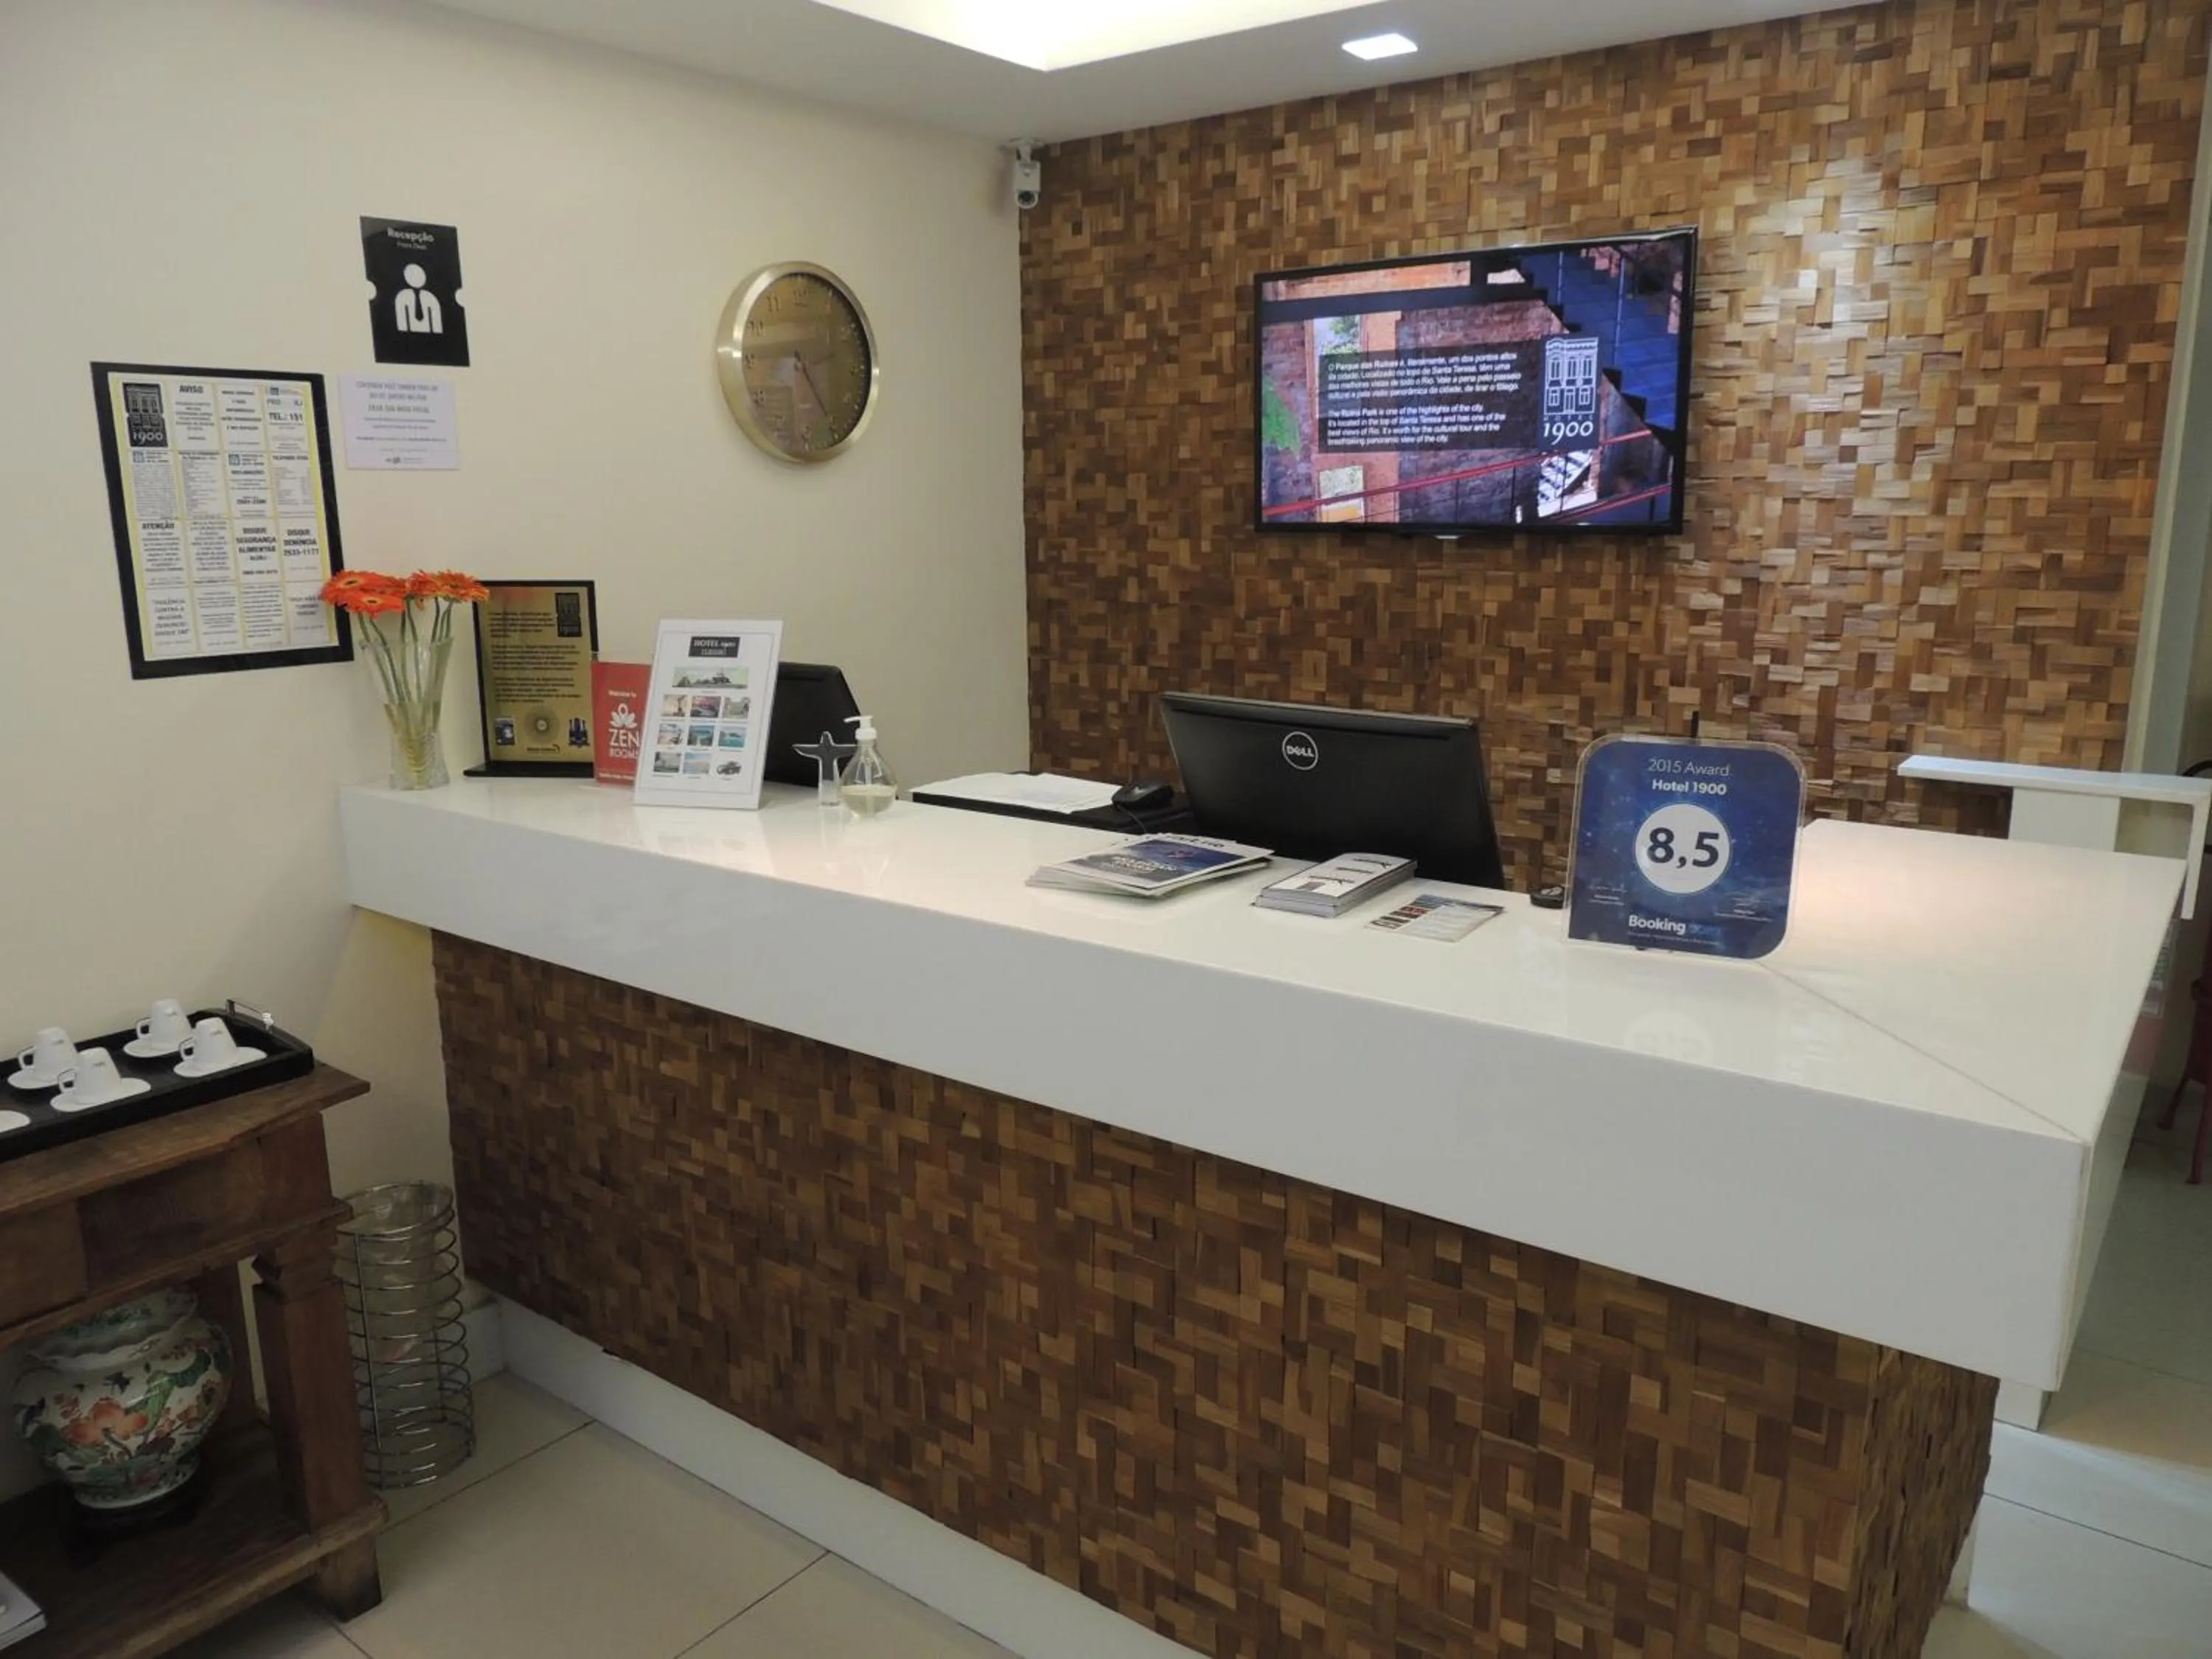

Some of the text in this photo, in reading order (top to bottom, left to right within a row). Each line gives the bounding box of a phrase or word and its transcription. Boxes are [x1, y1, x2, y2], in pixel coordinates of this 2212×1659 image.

[388, 227, 434, 243] Recepção
[1335, 362, 1359, 371] Parque
[1361, 361, 1372, 369] das
[1475, 354, 1499, 364] pontos
[1500, 352, 1517, 361] altos
[1361, 369, 1396, 379] Localizado
[1432, 366, 1452, 375] Santa
[1340, 381, 1369, 389] melhores
[1458, 375, 1476, 384] pena
[1477, 374, 1492, 383] pelo
[1493, 373, 1521, 382] passeio
[178, 385, 204, 393] AVISO
[1328, 409, 1340, 417] The
[1341, 408, 1360, 417] Ruins
[1362, 408, 1377, 416] Park
[1419, 406, 1450, 415] highlights
[1459, 403, 1471, 412] the
[1338, 418, 1360, 427] located
[1399, 416, 1418, 424] Santa
[1419, 414, 1442, 423] Teresa
[1443, 414, 1456, 422] and
[1457, 414, 1470, 422] has
[1494, 412, 1506, 421] the
[1328, 429, 1341, 437] best
[1393, 425, 1411, 434] worth
[1421, 425, 1433, 433] the
[1433, 424, 1458, 432] cultural
[1458, 424, 1473, 432] tour
[1473, 423, 1487, 431] and
[1488, 422, 1500, 431] the
[1543, 421, 1593, 445] 1900
[133, 431, 163, 445] 1900
[1328, 437, 1366, 448] breathtaking
[1367, 437, 1399, 445] panoramic
[1424, 434, 1435, 443] the
[142, 519, 175, 530] ATENÇÃO
[694, 639, 718, 647] HOTEL
[609, 728, 640, 747] ZEN
[1286, 745, 1314, 757] DELL
[1648, 758, 1731, 776] 2015 Award
[1652, 779, 1727, 796] Hotel 1900
[1646, 827, 1720, 869] 8,5
